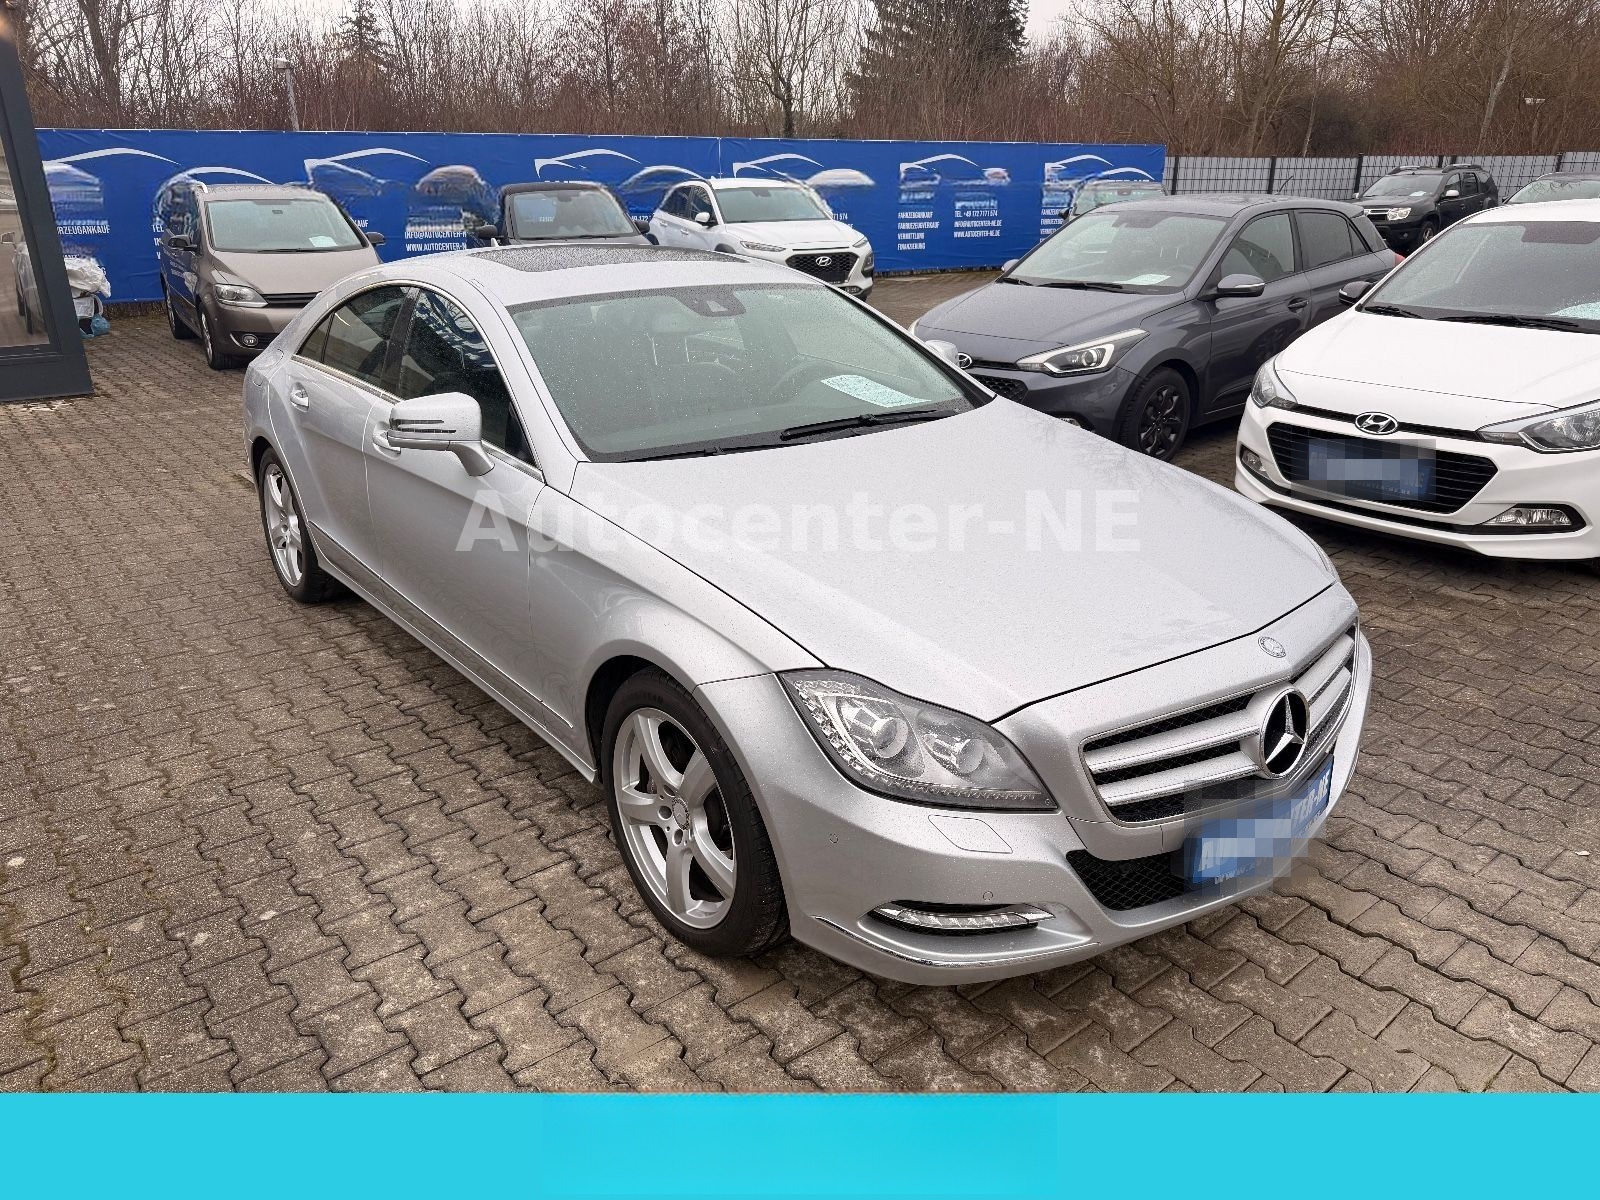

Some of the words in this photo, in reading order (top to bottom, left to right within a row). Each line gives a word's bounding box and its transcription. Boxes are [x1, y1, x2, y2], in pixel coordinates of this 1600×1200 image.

[57, 224, 110, 234] RZEUGANKAUF
[405, 231, 467, 239] INFO@AUTOCENTER-N
[406, 243, 467, 251] WWW.AUTOCENTER-N
